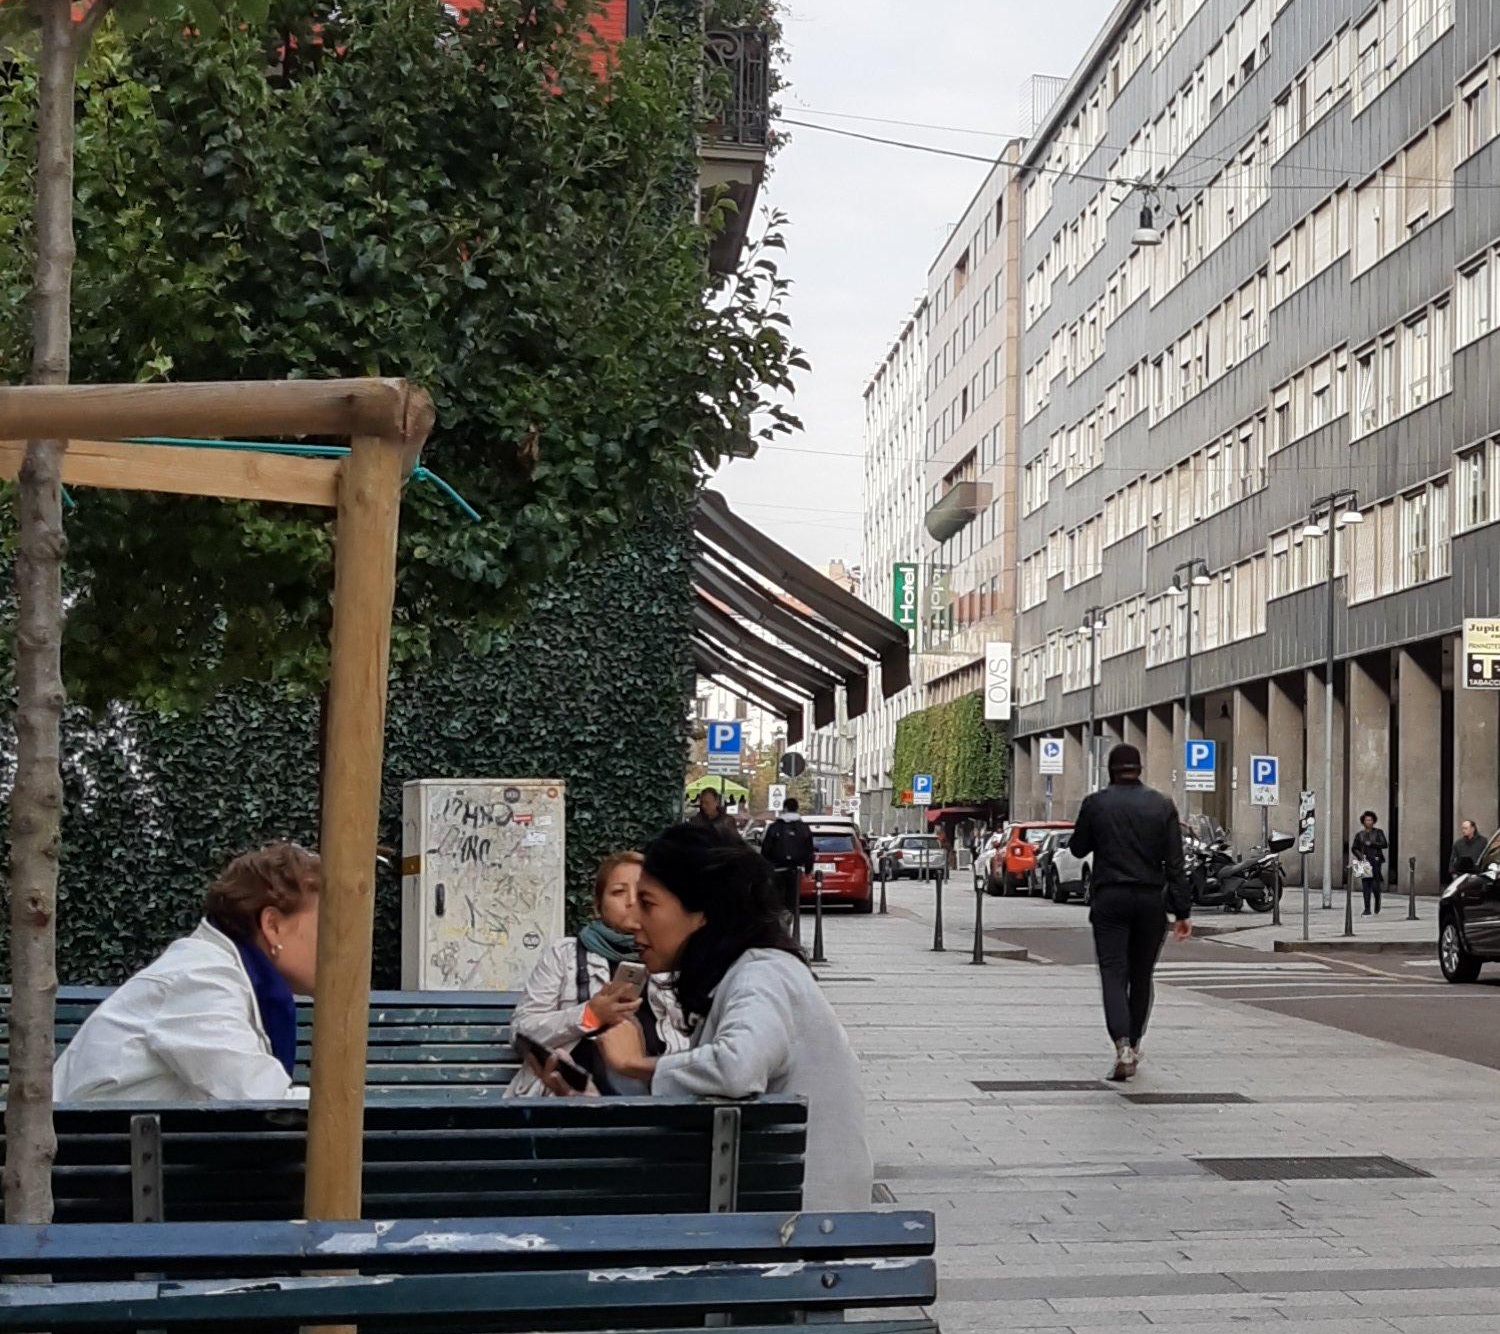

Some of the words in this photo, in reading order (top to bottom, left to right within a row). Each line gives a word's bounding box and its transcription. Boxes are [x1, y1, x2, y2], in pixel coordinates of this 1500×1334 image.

[899, 567, 915, 624] Hotel
[988, 658, 1009, 704] OVS
[715, 724, 735, 750] P
[1190, 743, 1209, 767] P
[916, 776, 928, 791] P
[1256, 761, 1272, 782] P
